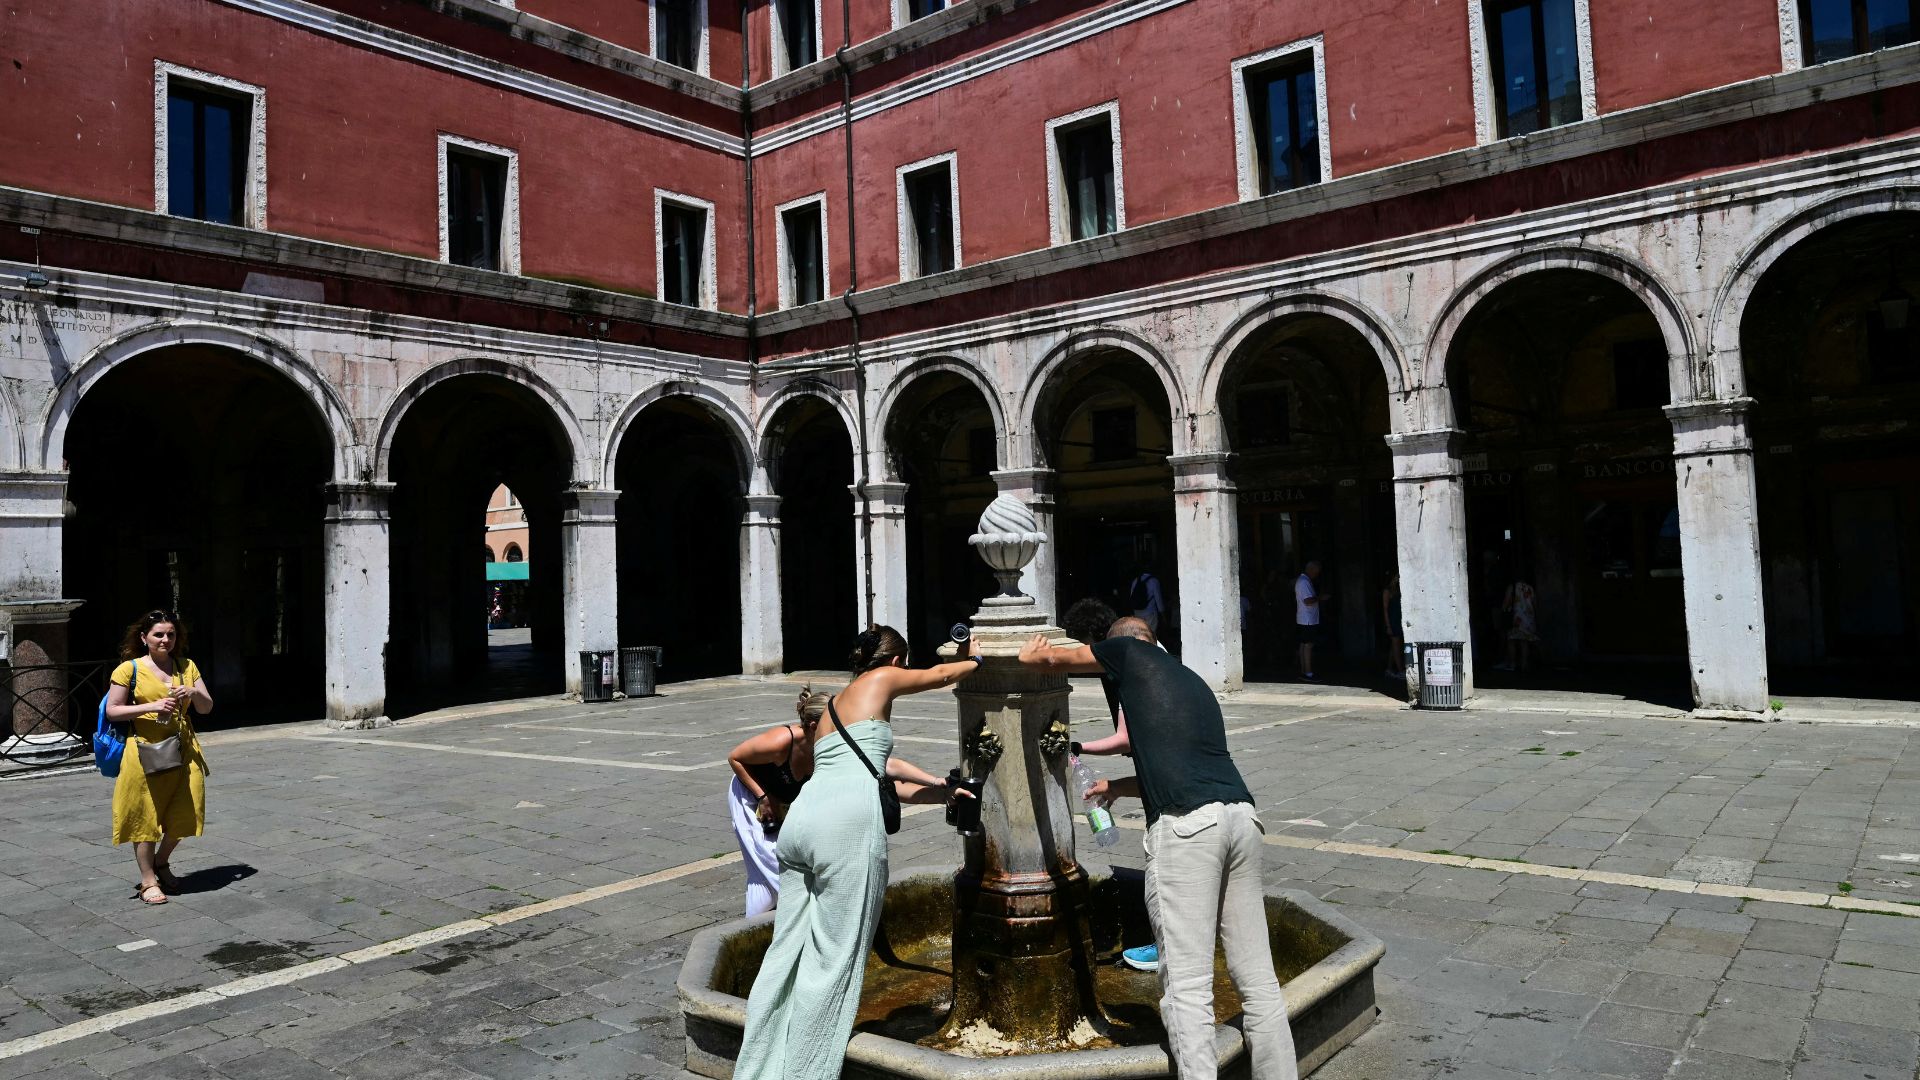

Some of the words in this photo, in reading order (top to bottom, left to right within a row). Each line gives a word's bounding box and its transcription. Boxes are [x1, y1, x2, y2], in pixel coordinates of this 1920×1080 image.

[79, 323, 111, 334] DVCIS
[1240, 488, 1304, 504] STERIA
[1425, 649, 1451, 657] VIETATO
